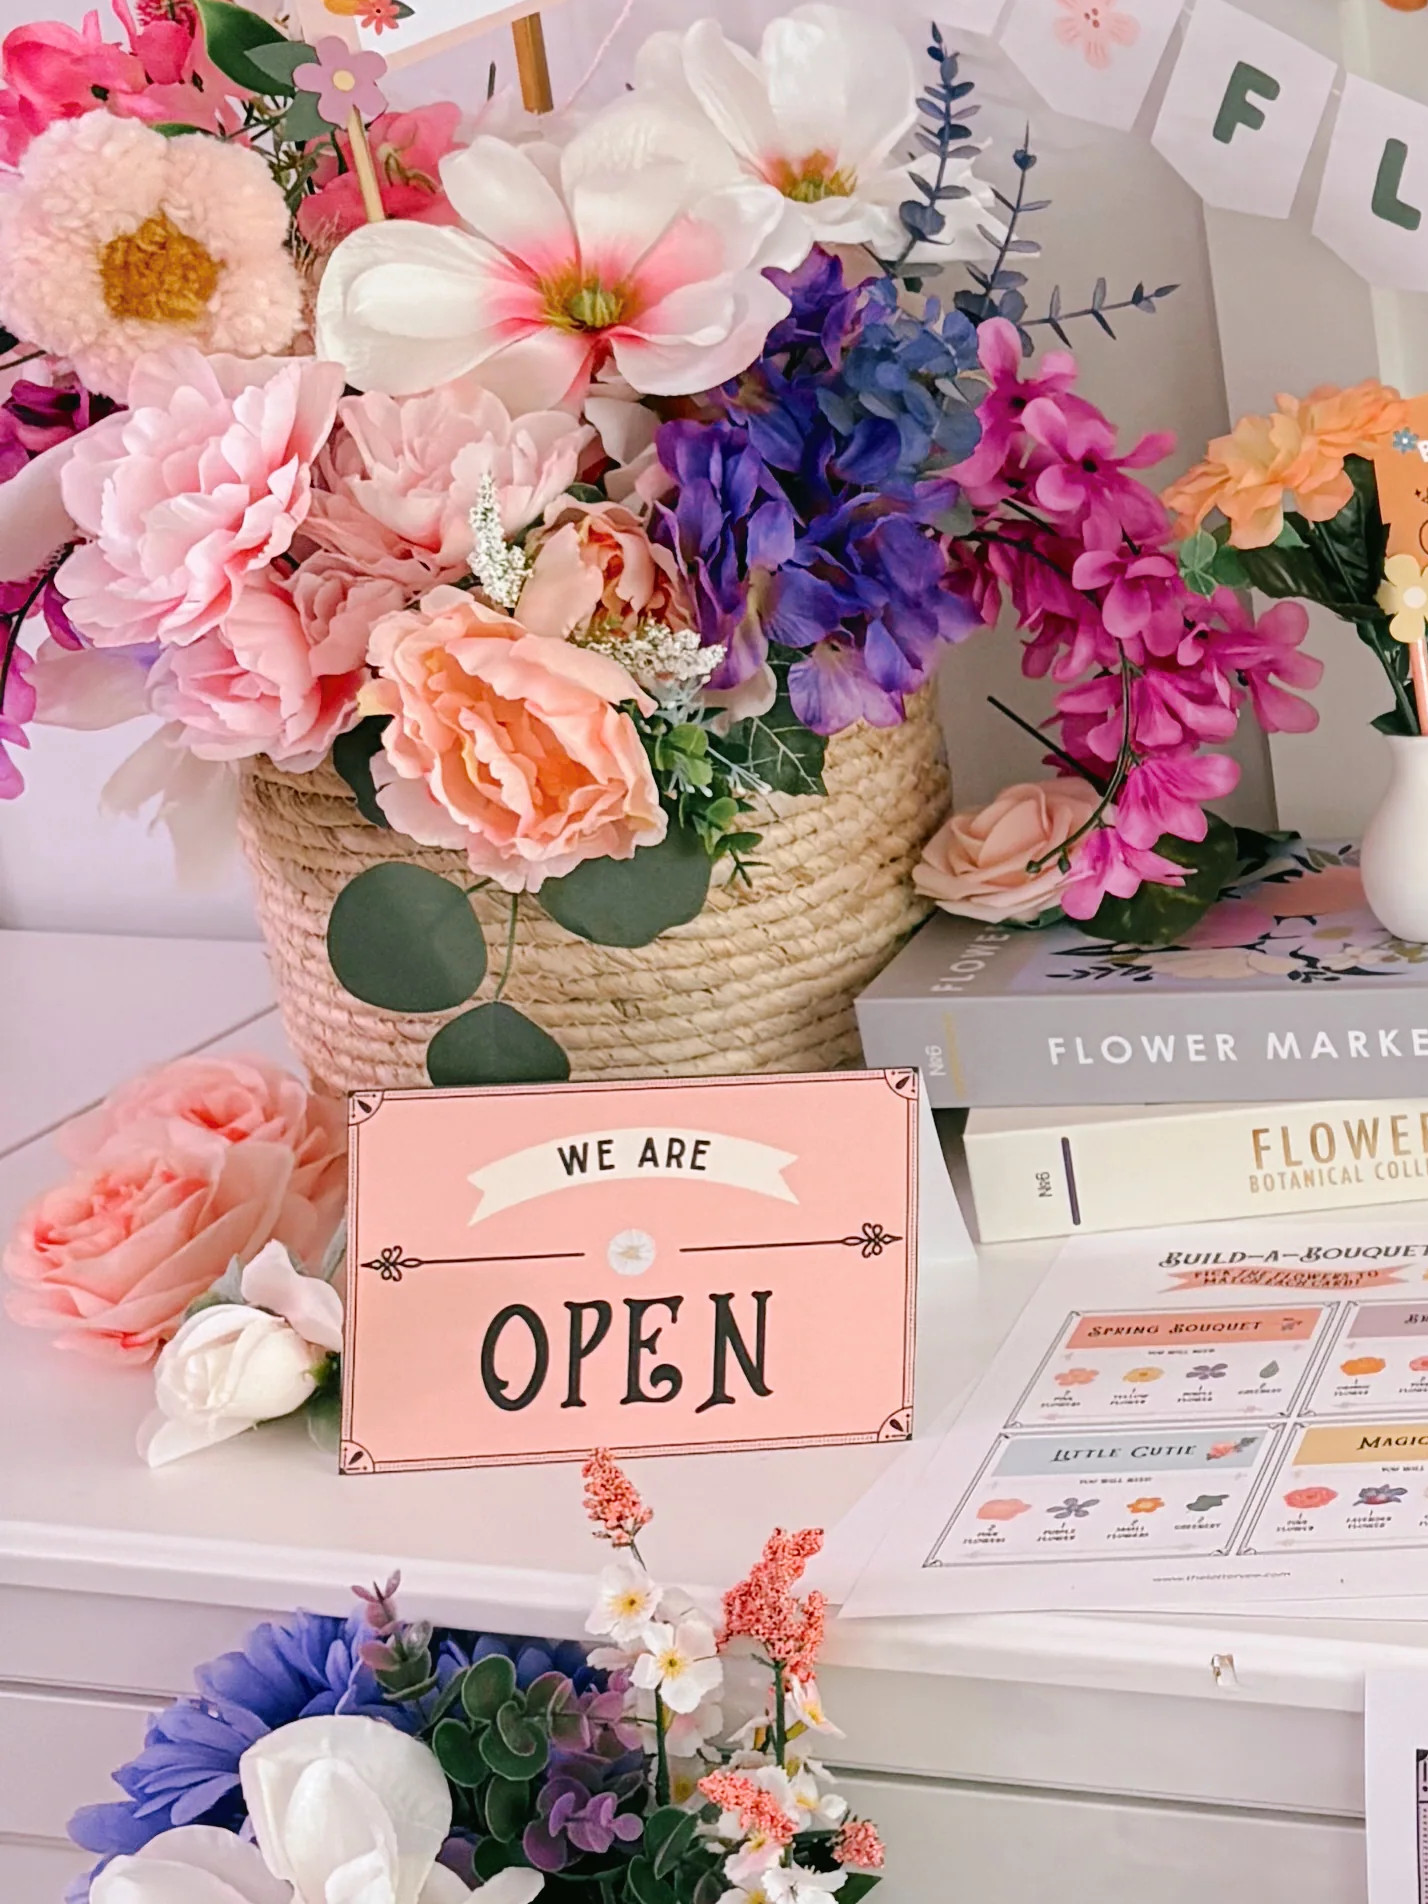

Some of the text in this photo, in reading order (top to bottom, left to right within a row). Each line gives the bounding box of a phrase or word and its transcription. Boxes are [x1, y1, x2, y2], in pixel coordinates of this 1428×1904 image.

[930, 926, 1011, 993] FLOWE
[1048, 1033, 1238, 1067] FLOWER
[556, 1137, 711, 1177] WE ARE
[1248, 1165, 1365, 1195] BOTANICAL
[1088, 1321, 1263, 1338] SPRING BOUQUET
[480, 1290, 774, 1414] OPEN
